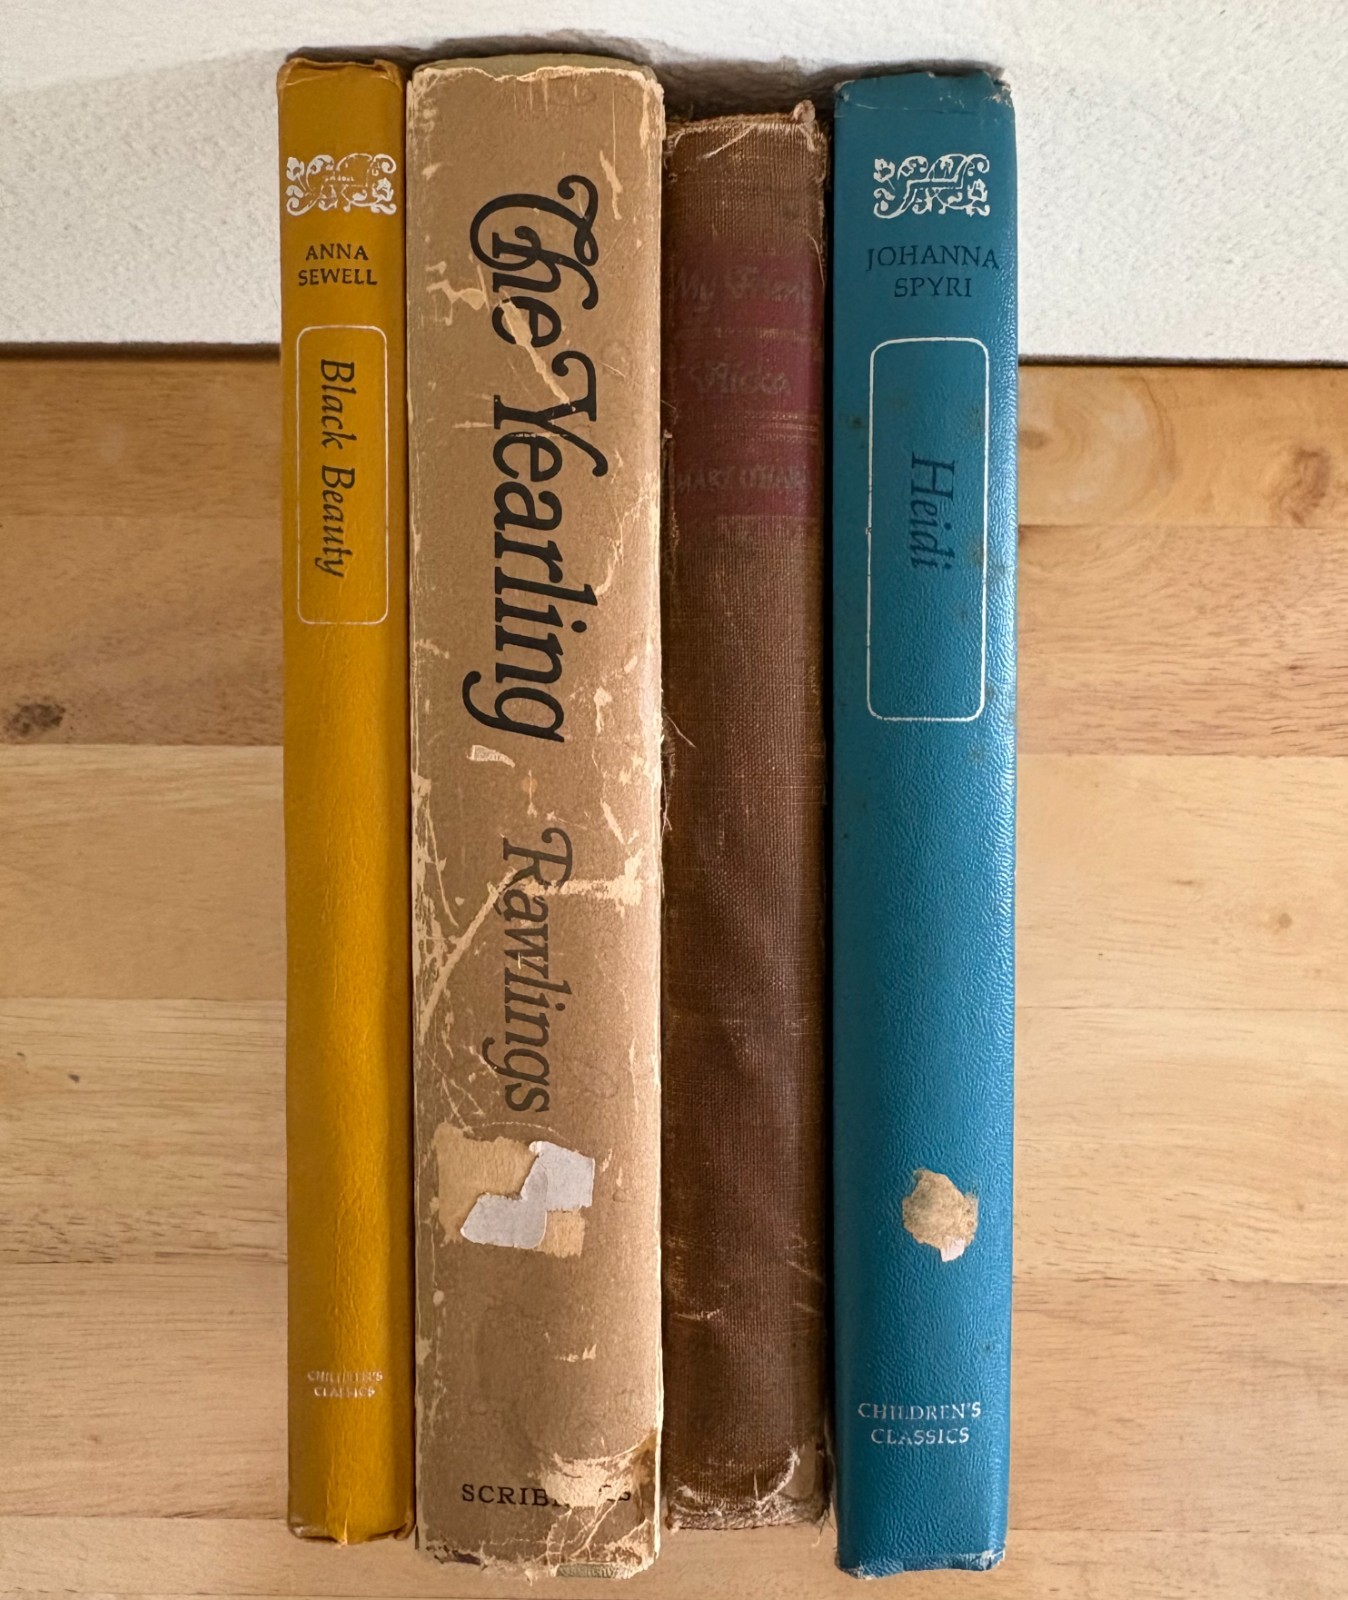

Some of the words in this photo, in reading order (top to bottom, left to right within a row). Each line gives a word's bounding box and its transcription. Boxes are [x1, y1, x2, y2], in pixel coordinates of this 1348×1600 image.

[305, 243, 369, 261] ANNA
[469, 174, 599, 348] The
[865, 244, 1000, 272] JOHANNA
[298, 268, 378, 286] SEWELL
[894, 276, 972, 298] SPYRI
[320, 358, 358, 449] Black
[314, 464, 356, 578] Beauty
[909, 450, 956, 569] Heidi
[462, 350, 609, 743] Yearling
[481, 826, 573, 1113] Rawlings
[857, 1401, 982, 1421] CHILDREN'S
[870, 1427, 970, 1446] CLASSICS
[461, 1483, 632, 1508] SCRIB
